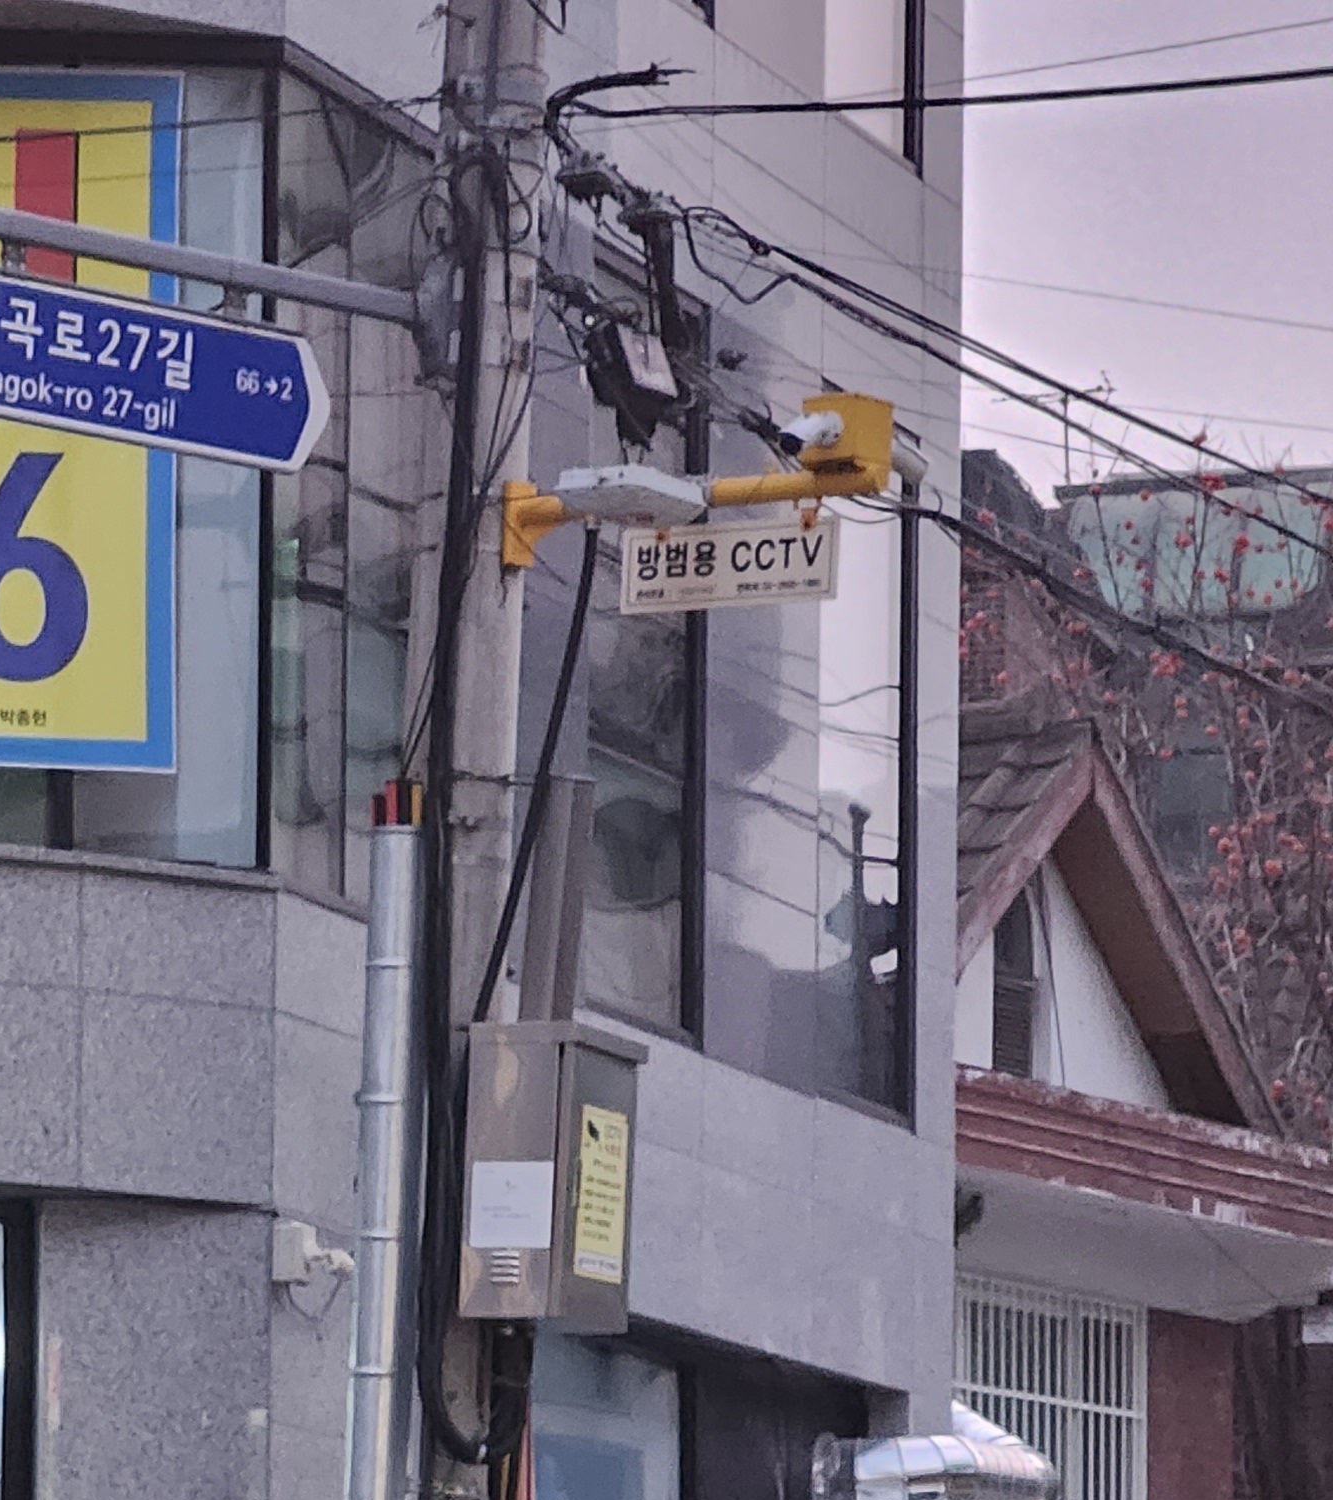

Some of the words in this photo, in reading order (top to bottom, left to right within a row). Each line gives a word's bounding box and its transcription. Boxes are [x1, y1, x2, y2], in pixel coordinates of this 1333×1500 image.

[101, 387, 176, 432] 27-gil
[637, 540, 717, 581] 방범용
[730, 533, 824, 573] CCTV
